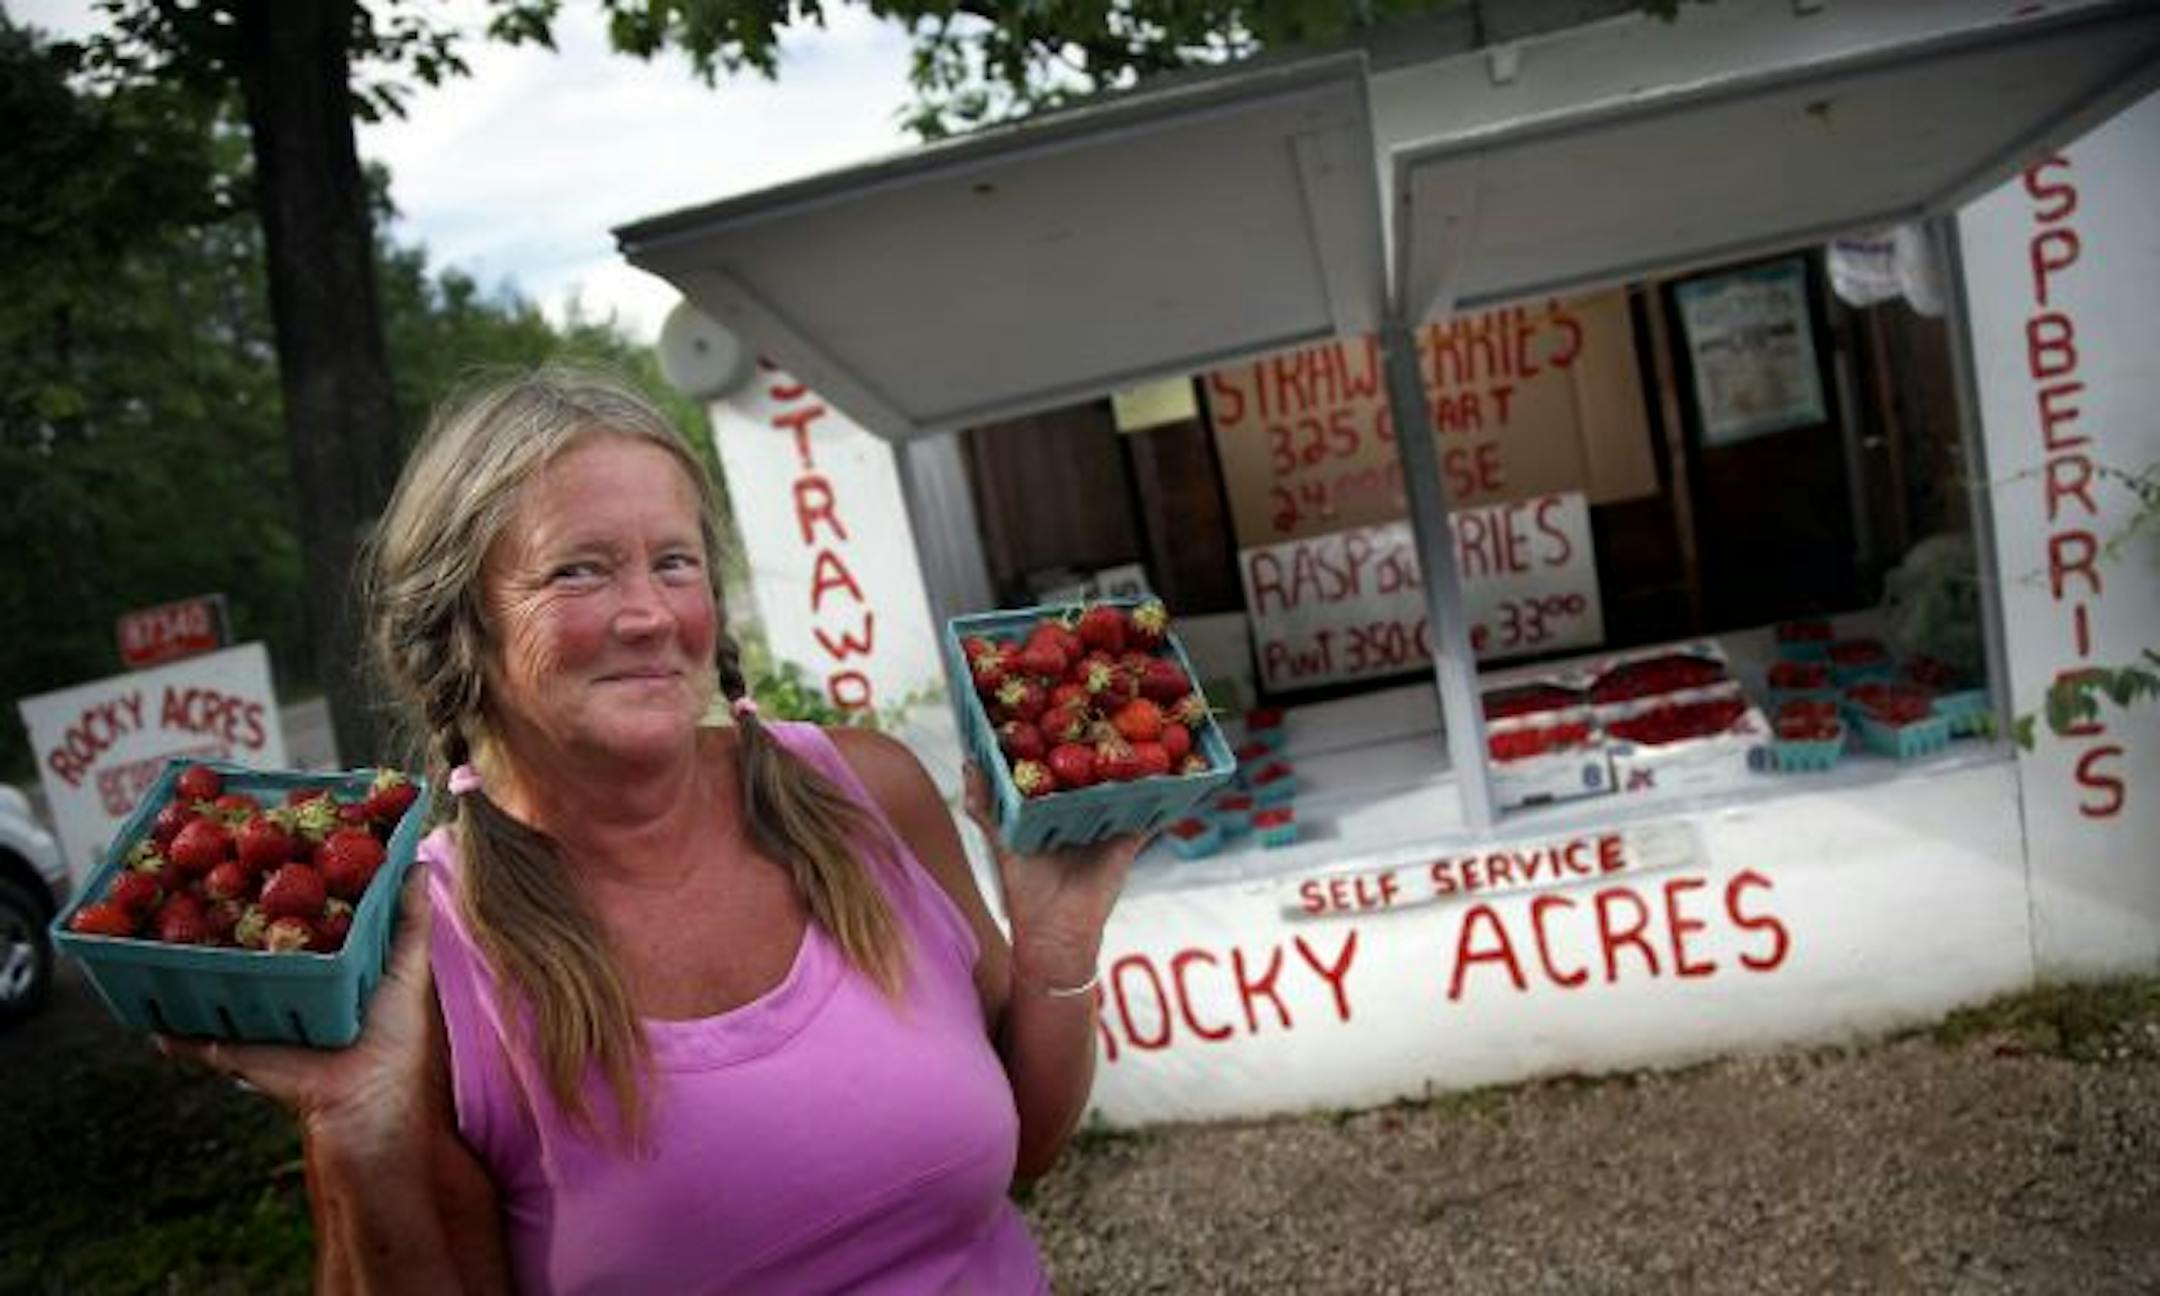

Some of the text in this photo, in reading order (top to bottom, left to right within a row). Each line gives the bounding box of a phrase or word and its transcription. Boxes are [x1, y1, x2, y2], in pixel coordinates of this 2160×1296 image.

[1211, 297, 1583, 427] STRAWRRIES
[1252, 490, 1571, 617] RASPBRIES
[49, 691, 144, 787] ROCKY
[160, 685, 265, 750] ACRES
[1300, 834, 1626, 914] SELF SERVICE
[1447, 869, 1790, 1001] ACRES
